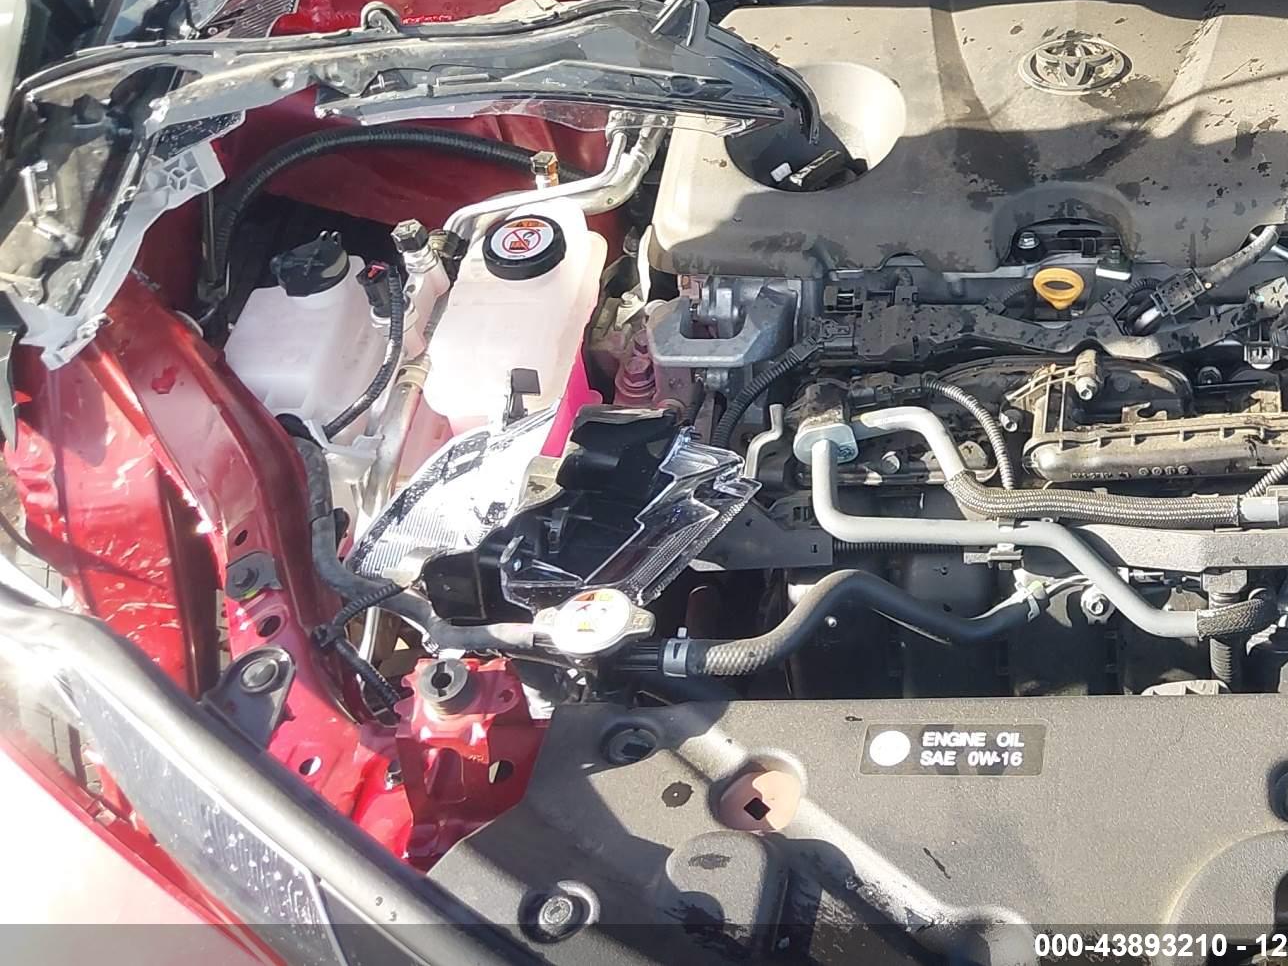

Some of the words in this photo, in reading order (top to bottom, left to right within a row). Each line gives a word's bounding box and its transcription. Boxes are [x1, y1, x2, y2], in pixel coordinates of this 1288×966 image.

[922, 731, 987, 747] ENGINE
[996, 731, 1024, 747] OIL
[920, 750, 956, 767] SAE
[967, 750, 1024, 767] 0W-16
